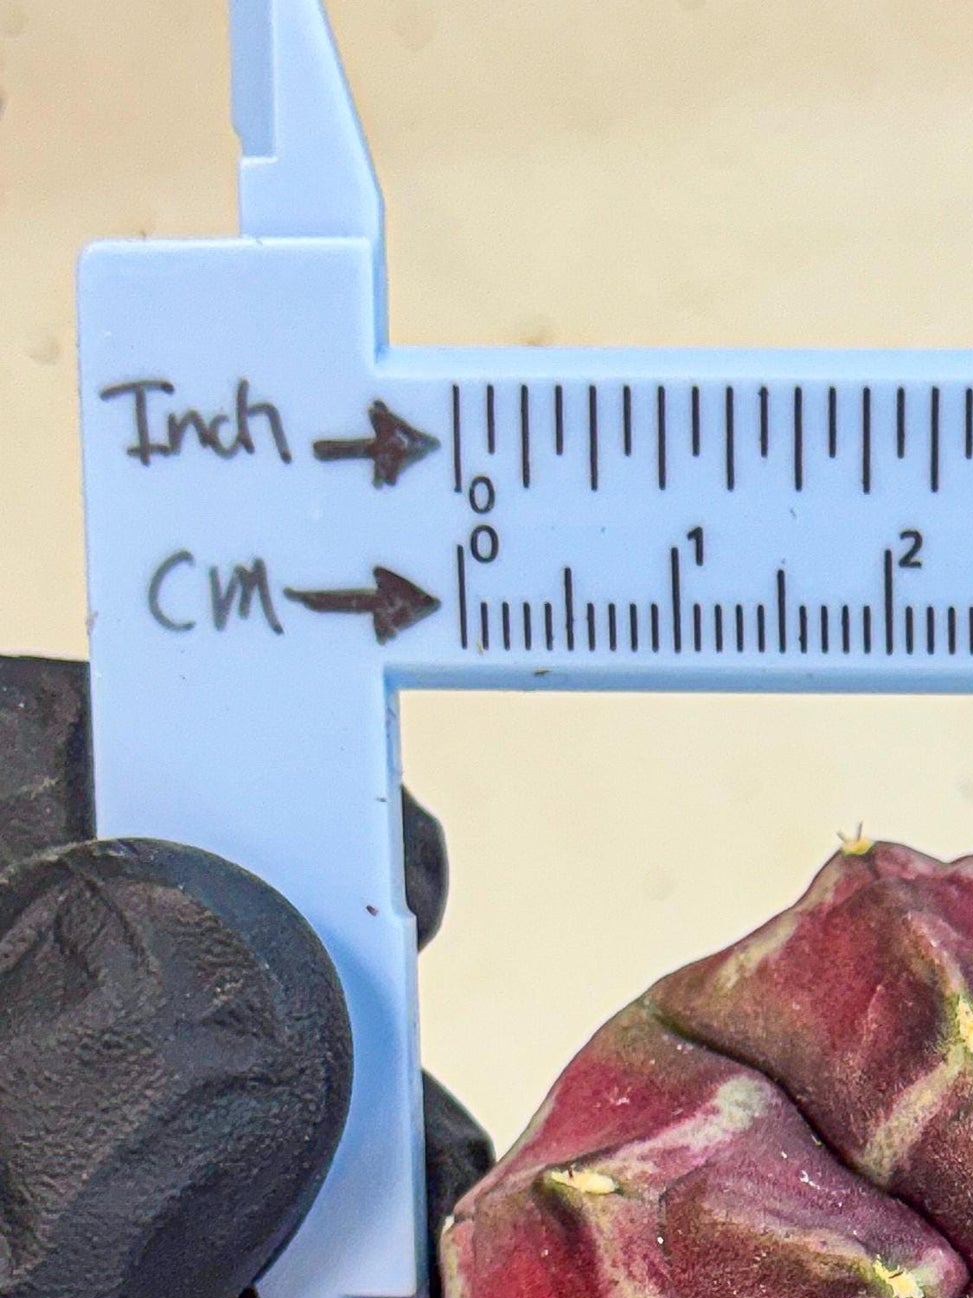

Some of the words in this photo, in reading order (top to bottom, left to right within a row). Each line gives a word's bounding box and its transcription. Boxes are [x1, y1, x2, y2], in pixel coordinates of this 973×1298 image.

[100, 378, 293, 467] Inch
[468, 475, 496, 515] 0
[470, 524, 500, 564] 0
[686, 525, 706, 568] 1
[898, 528, 924, 569] 2
